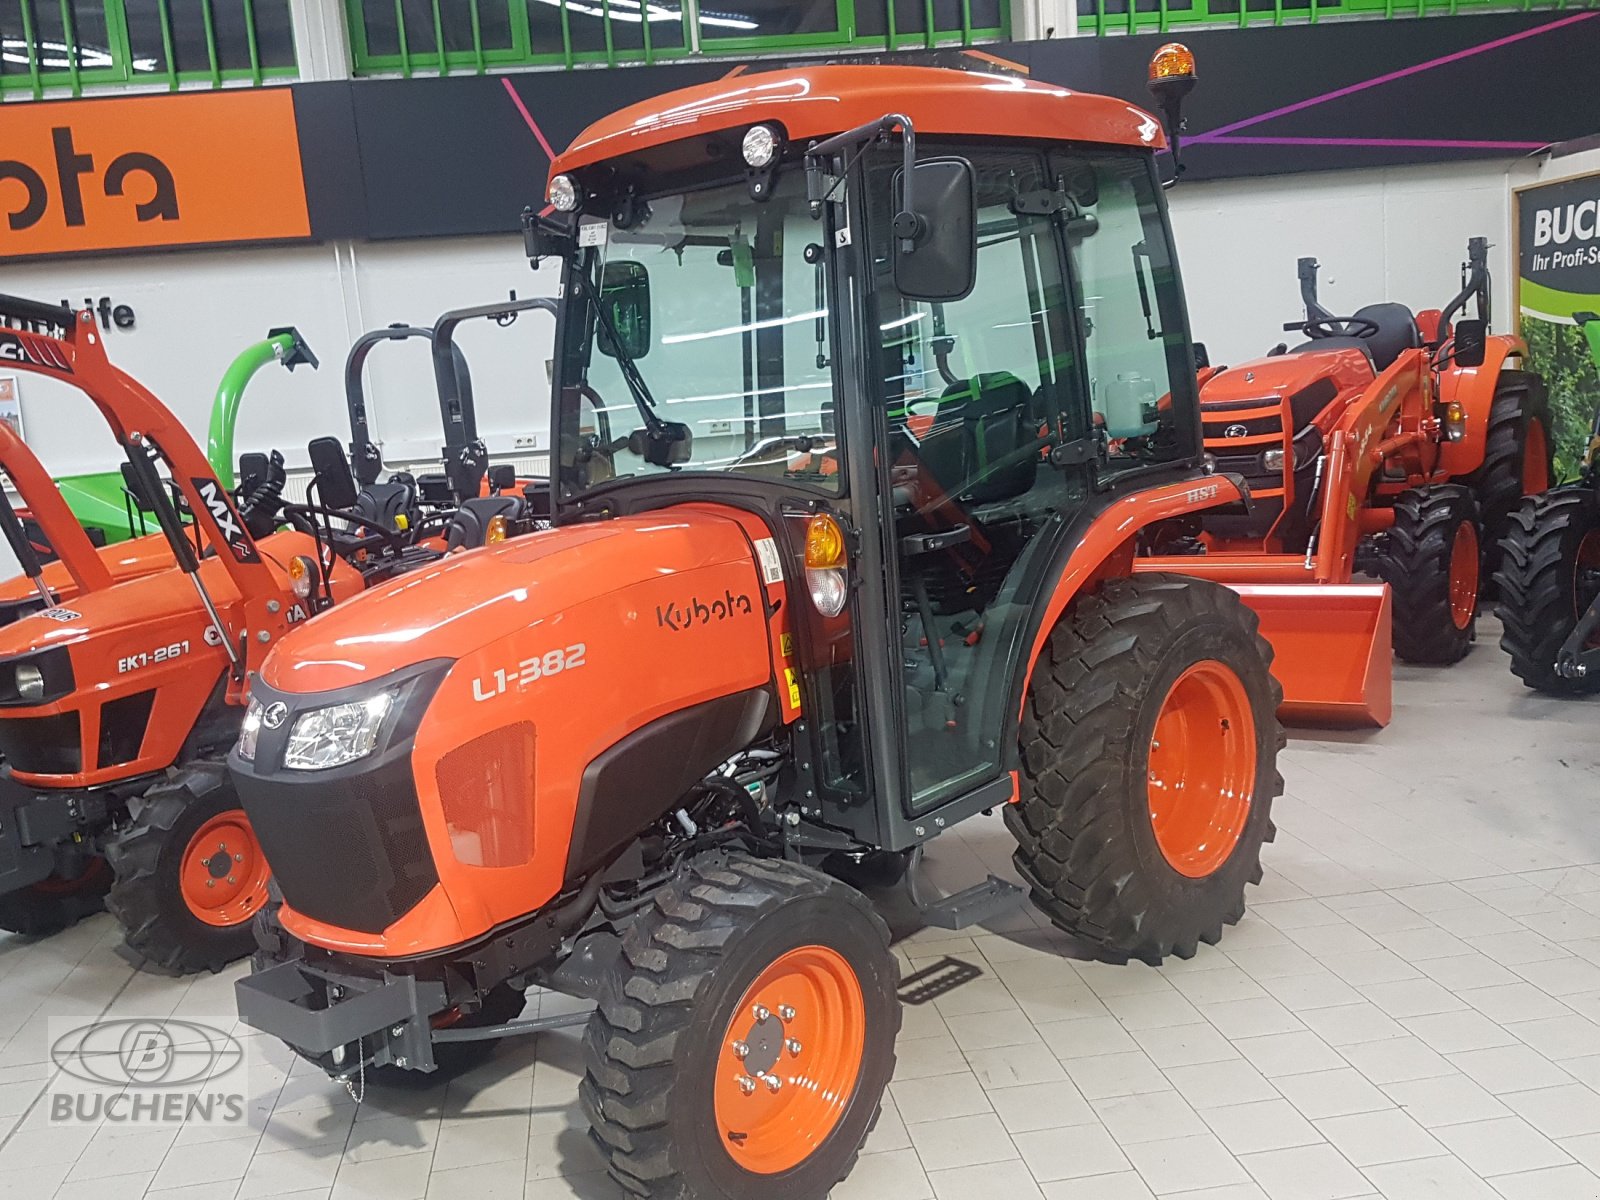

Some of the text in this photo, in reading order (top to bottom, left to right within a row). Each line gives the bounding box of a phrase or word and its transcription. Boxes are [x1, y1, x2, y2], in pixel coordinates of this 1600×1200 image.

[1534, 199, 1600, 247] BUC
[1532, 253, 1550, 271] Ihr
[200, 482, 243, 542] MX
[1187, 484, 1218, 504] HST
[656, 590, 752, 631] Kubota
[118, 640, 190, 673] EK1-261
[472, 643, 586, 702] L1-382
